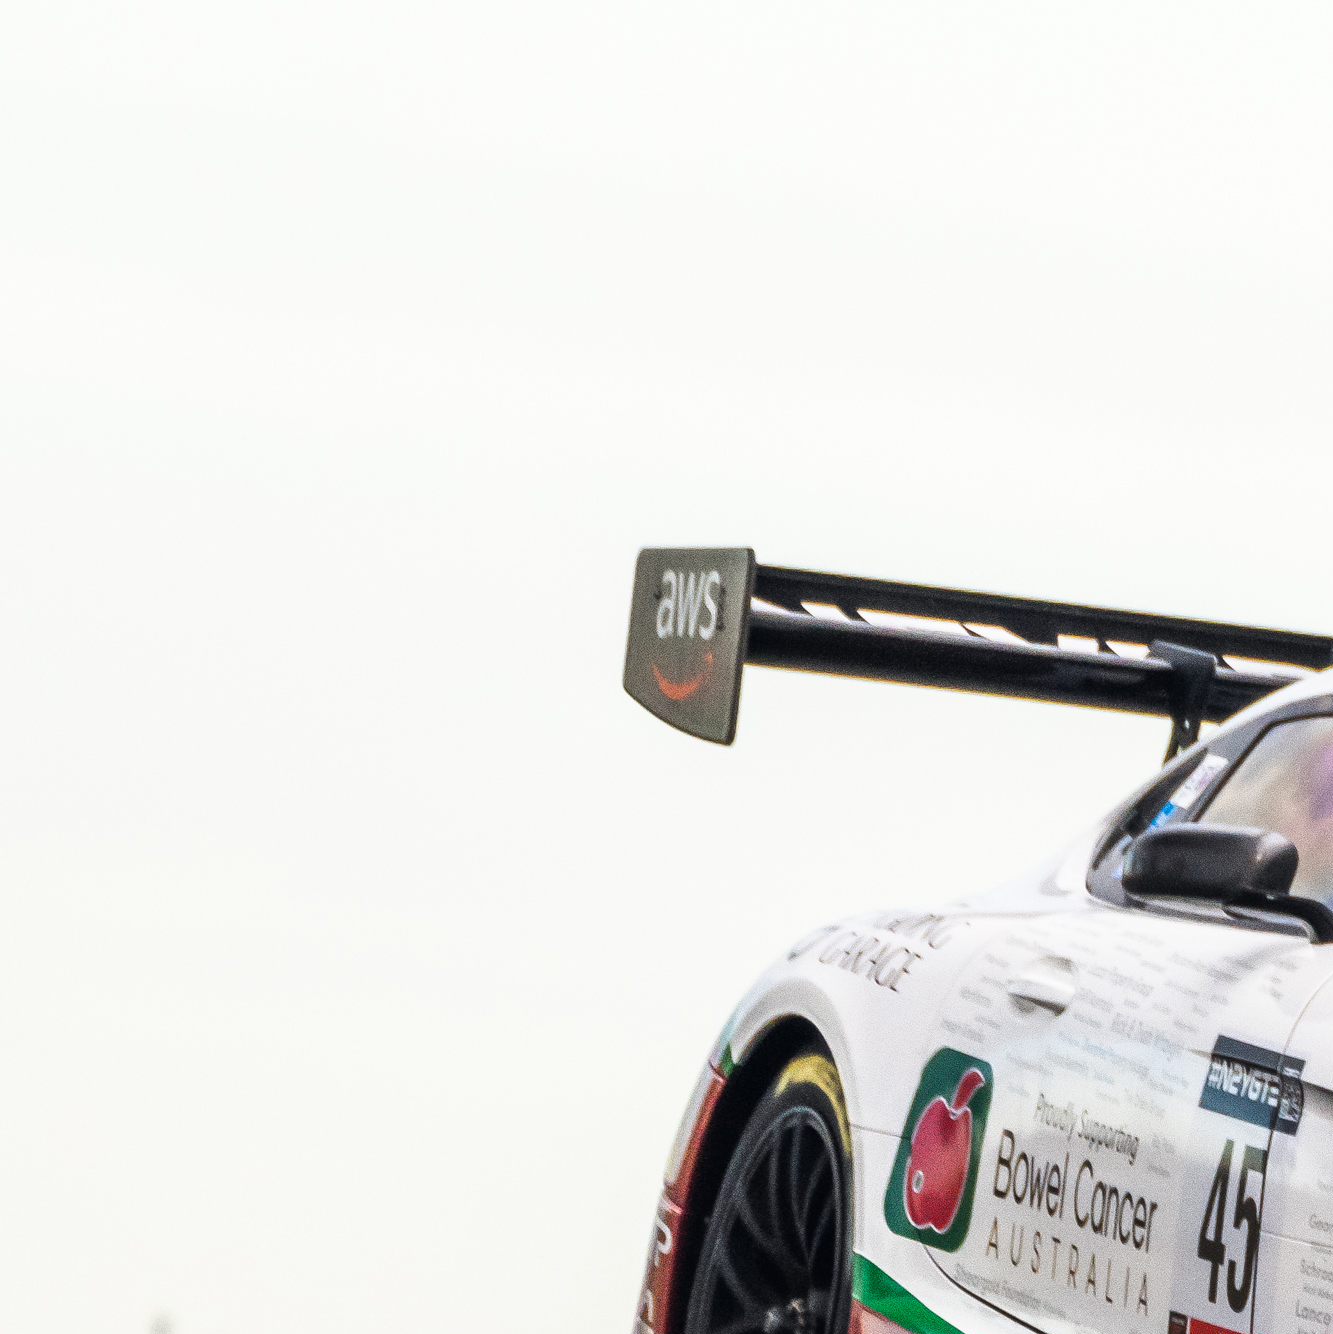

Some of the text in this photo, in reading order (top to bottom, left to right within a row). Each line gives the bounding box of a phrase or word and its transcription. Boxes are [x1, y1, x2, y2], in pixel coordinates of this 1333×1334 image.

[656, 569, 720, 640] aws
[993, 1128, 1158, 1254] Bowel Cancer
[1196, 1138, 1268, 1314] 45
[984, 1216, 1149, 1317] AUSTRALIA
